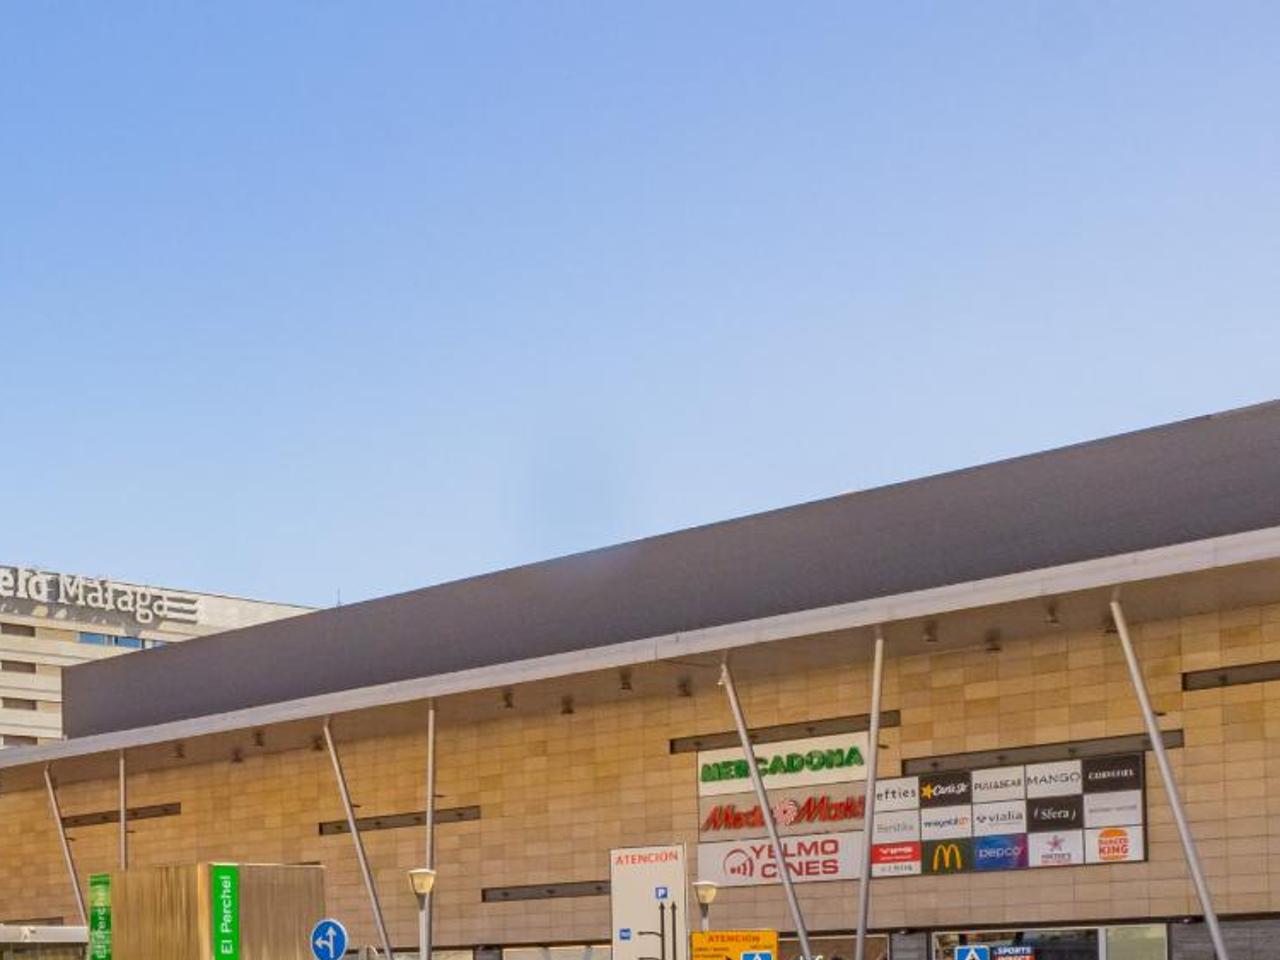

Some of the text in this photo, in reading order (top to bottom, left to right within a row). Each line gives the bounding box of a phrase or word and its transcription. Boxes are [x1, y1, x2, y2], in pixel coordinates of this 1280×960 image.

[701, 746, 864, 783] MERCADONA
[1027, 772, 1081, 785] MANGO
[877, 788, 916, 801] efties
[750, 839, 840, 860] YELMO
[979, 846, 1022, 860] pepco
[1099, 845, 1129, 855] KING
[761, 859, 840, 878] CNES
[220, 875, 233, 954] El Perchel
